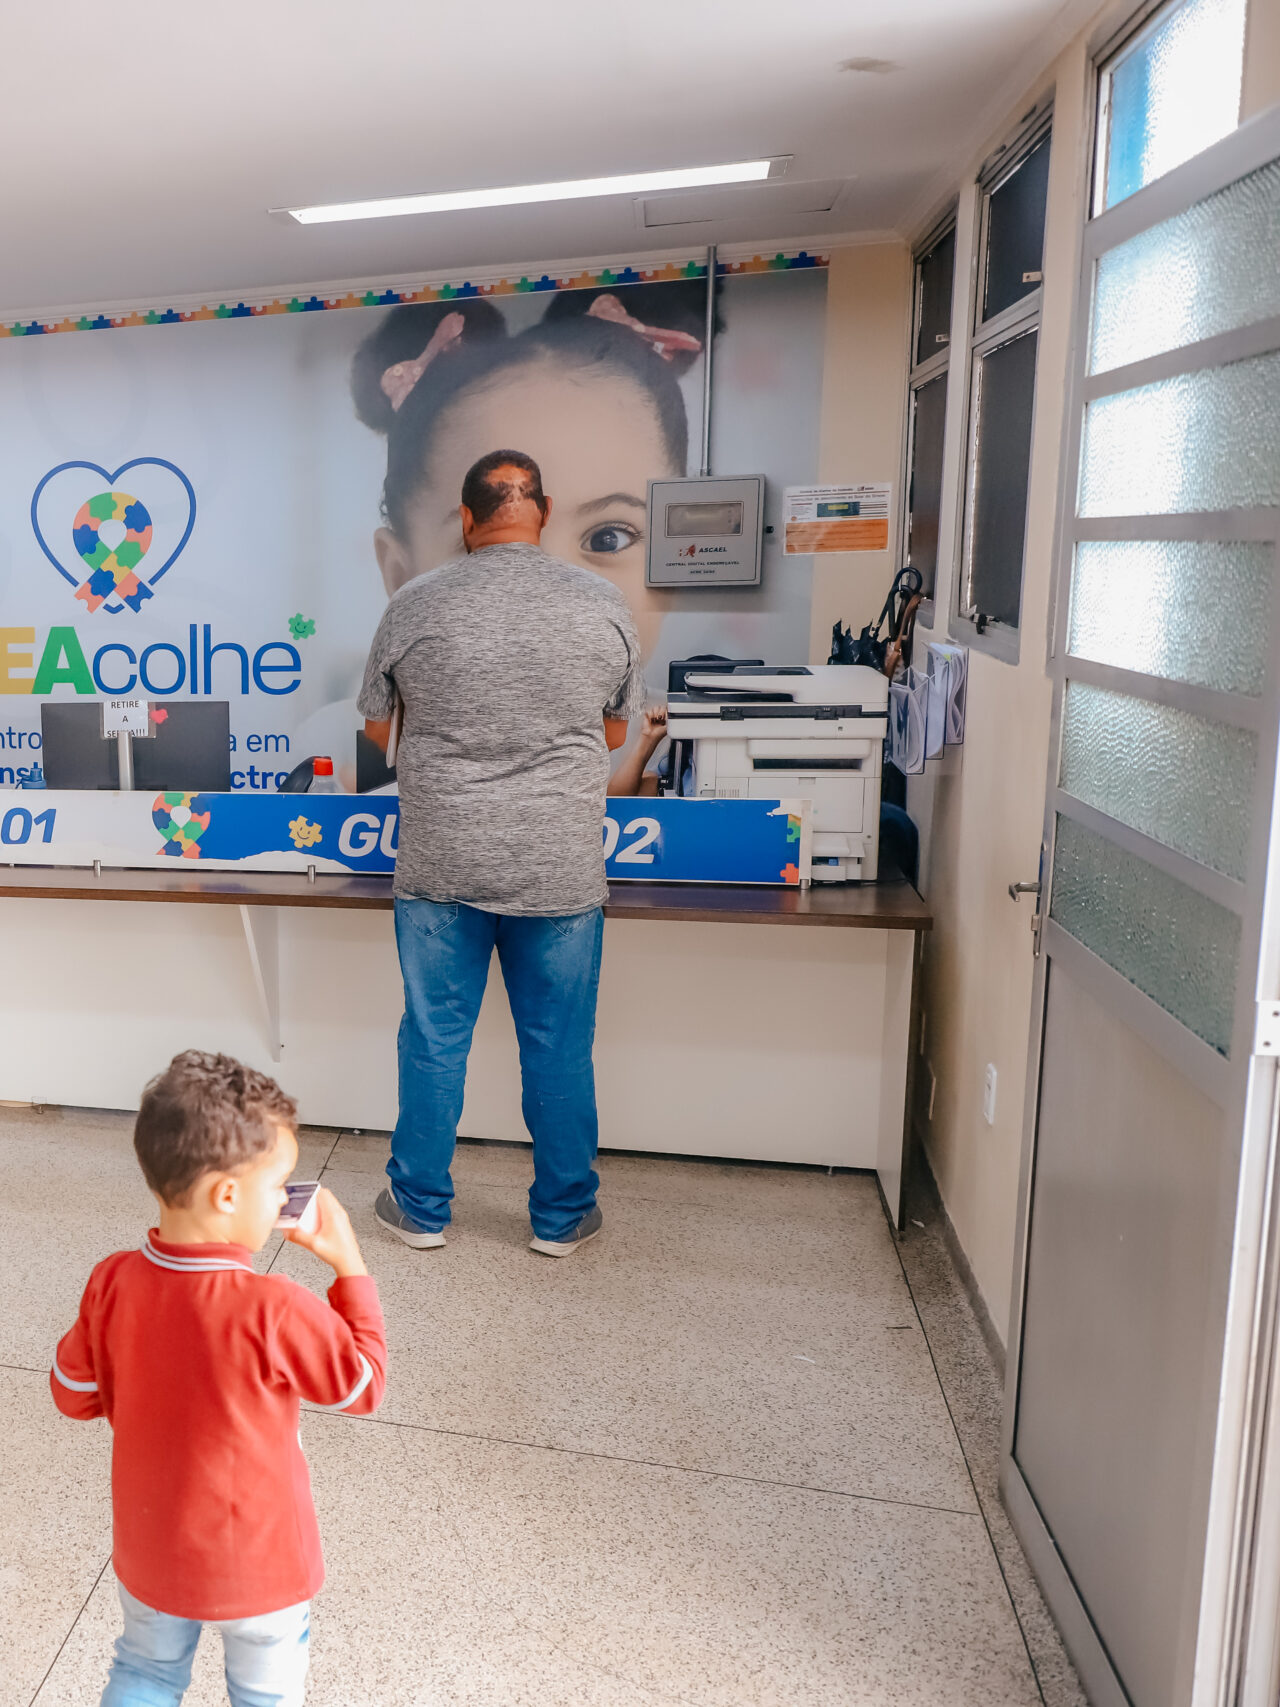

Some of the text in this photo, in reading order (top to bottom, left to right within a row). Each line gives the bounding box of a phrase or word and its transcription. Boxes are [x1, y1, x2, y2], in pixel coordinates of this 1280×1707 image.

[111, 701, 139, 709] RETIRE
[122, 715, 129, 723] A
[246, 733, 290, 753] em
[0, 808, 57, 844] 01
